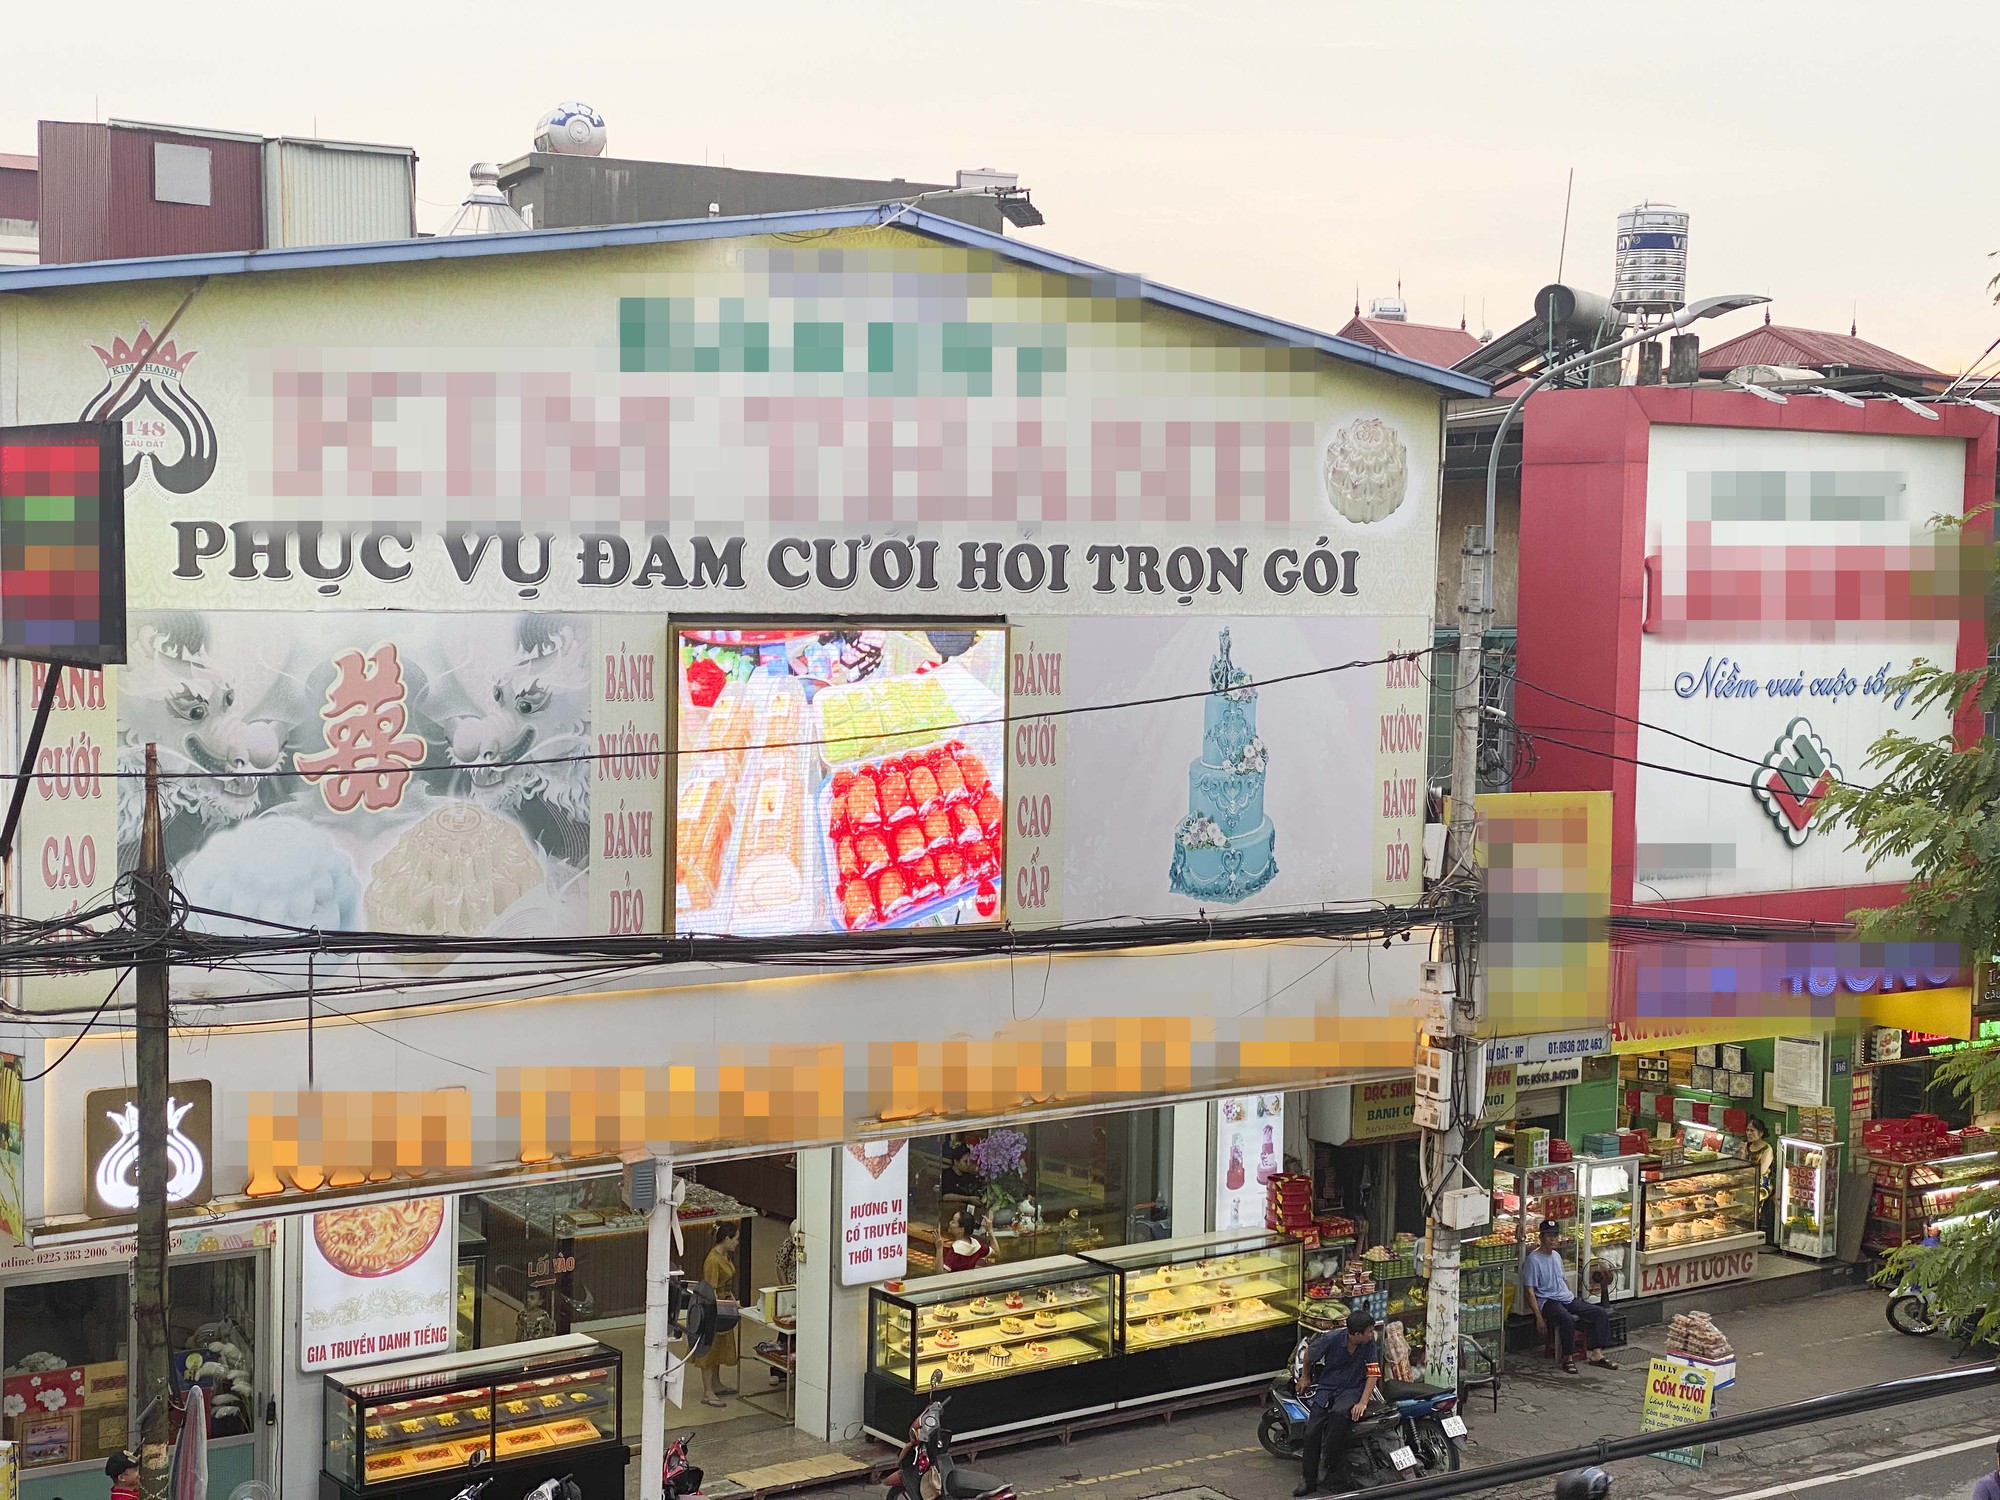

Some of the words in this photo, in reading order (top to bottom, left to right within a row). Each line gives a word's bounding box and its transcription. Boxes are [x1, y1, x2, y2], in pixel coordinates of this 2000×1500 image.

[112, 364, 135, 375] KIM
[141, 364, 178, 378] HANH
[124, 420, 166, 436] 148
[170, 520, 414, 596] PHỤC
[440, 522, 556, 599] VỤ
[1085, 543, 1248, 606] TRỌN
[1262, 534, 1360, 597] GÓI
[604, 641, 655, 701] BÁNH
[1013, 641, 1062, 695] BÁNH
[1385, 639, 1420, 689] BÁNH
[1674, 656, 1759, 699] Niềm
[1766, 670, 1804, 698] vui
[1809, 667, 1857, 704] cuộc
[597, 720, 660, 781] NƯỚNG
[1015, 715, 1058, 768] CƯỚI
[1379, 703, 1423, 754] NƯỚNG
[37, 731, 102, 800] CƯỚI
[1016, 794, 1052, 838] CAO
[1382, 768, 1417, 818] BÁNH
[603, 799, 653, 859] BÁNH
[42, 834, 97, 890] CAO
[1016, 846, 1051, 909] CẤP
[1385, 828, 1410, 882] DẺO
[609, 870, 645, 935] DẺO
[846, 1223, 861, 1243] CỔ
[850, 1201, 888, 1219] HƯƠNG
[891, 1199, 902, 1215] VỊ
[0, 1257, 34, 1268] otline:
[37, 1251, 61, 1264] 0225
[63, 1250, 81, 1261] 383
[84, 1247, 107, 1259] 2006
[527, 1253, 549, 1277] LỐI
[553, 1252, 575, 1273] VÀO
[849, 1246, 873, 1265] THỜI
[877, 1244, 903, 1260] 1954
[1642, 1263, 1681, 1292] LÂM
[1685, 1251, 1753, 1283] HƯƠNG
[307, 1345, 327, 1363] GIA
[330, 1333, 375, 1360] TRUYỀN
[378, 1331, 411, 1352] DANH
[413, 1323, 447, 1346] TIẾNG
[1652, 1375, 1677, 1398] CỐM
[1679, 1382, 1706, 1404] TƯƠI
